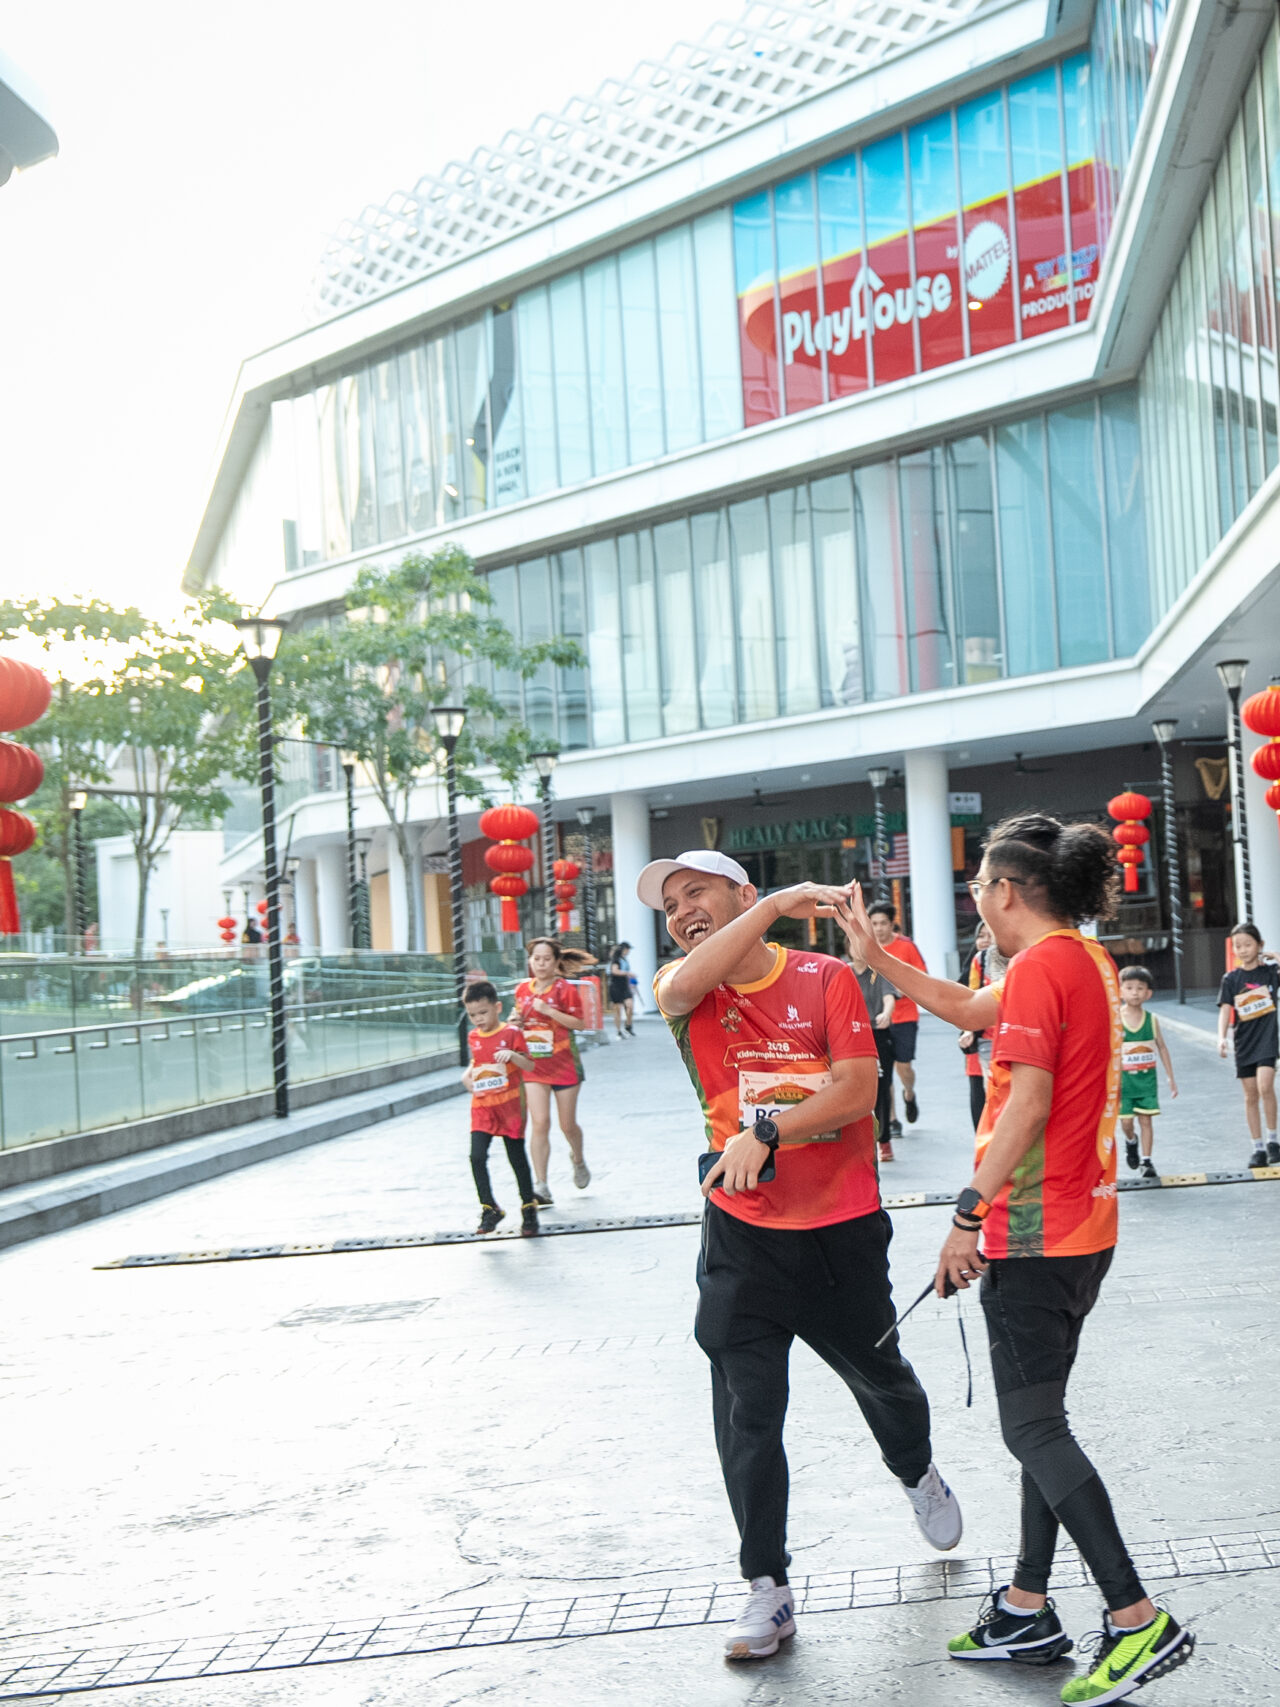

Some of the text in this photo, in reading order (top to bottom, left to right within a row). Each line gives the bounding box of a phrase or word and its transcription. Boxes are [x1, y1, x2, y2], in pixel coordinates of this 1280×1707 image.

[965, 240, 1012, 281] MATTEL
[1023, 273, 1035, 292] A
[730, 822, 787, 849] HEALY
[792, 817, 848, 840] MAC'S
